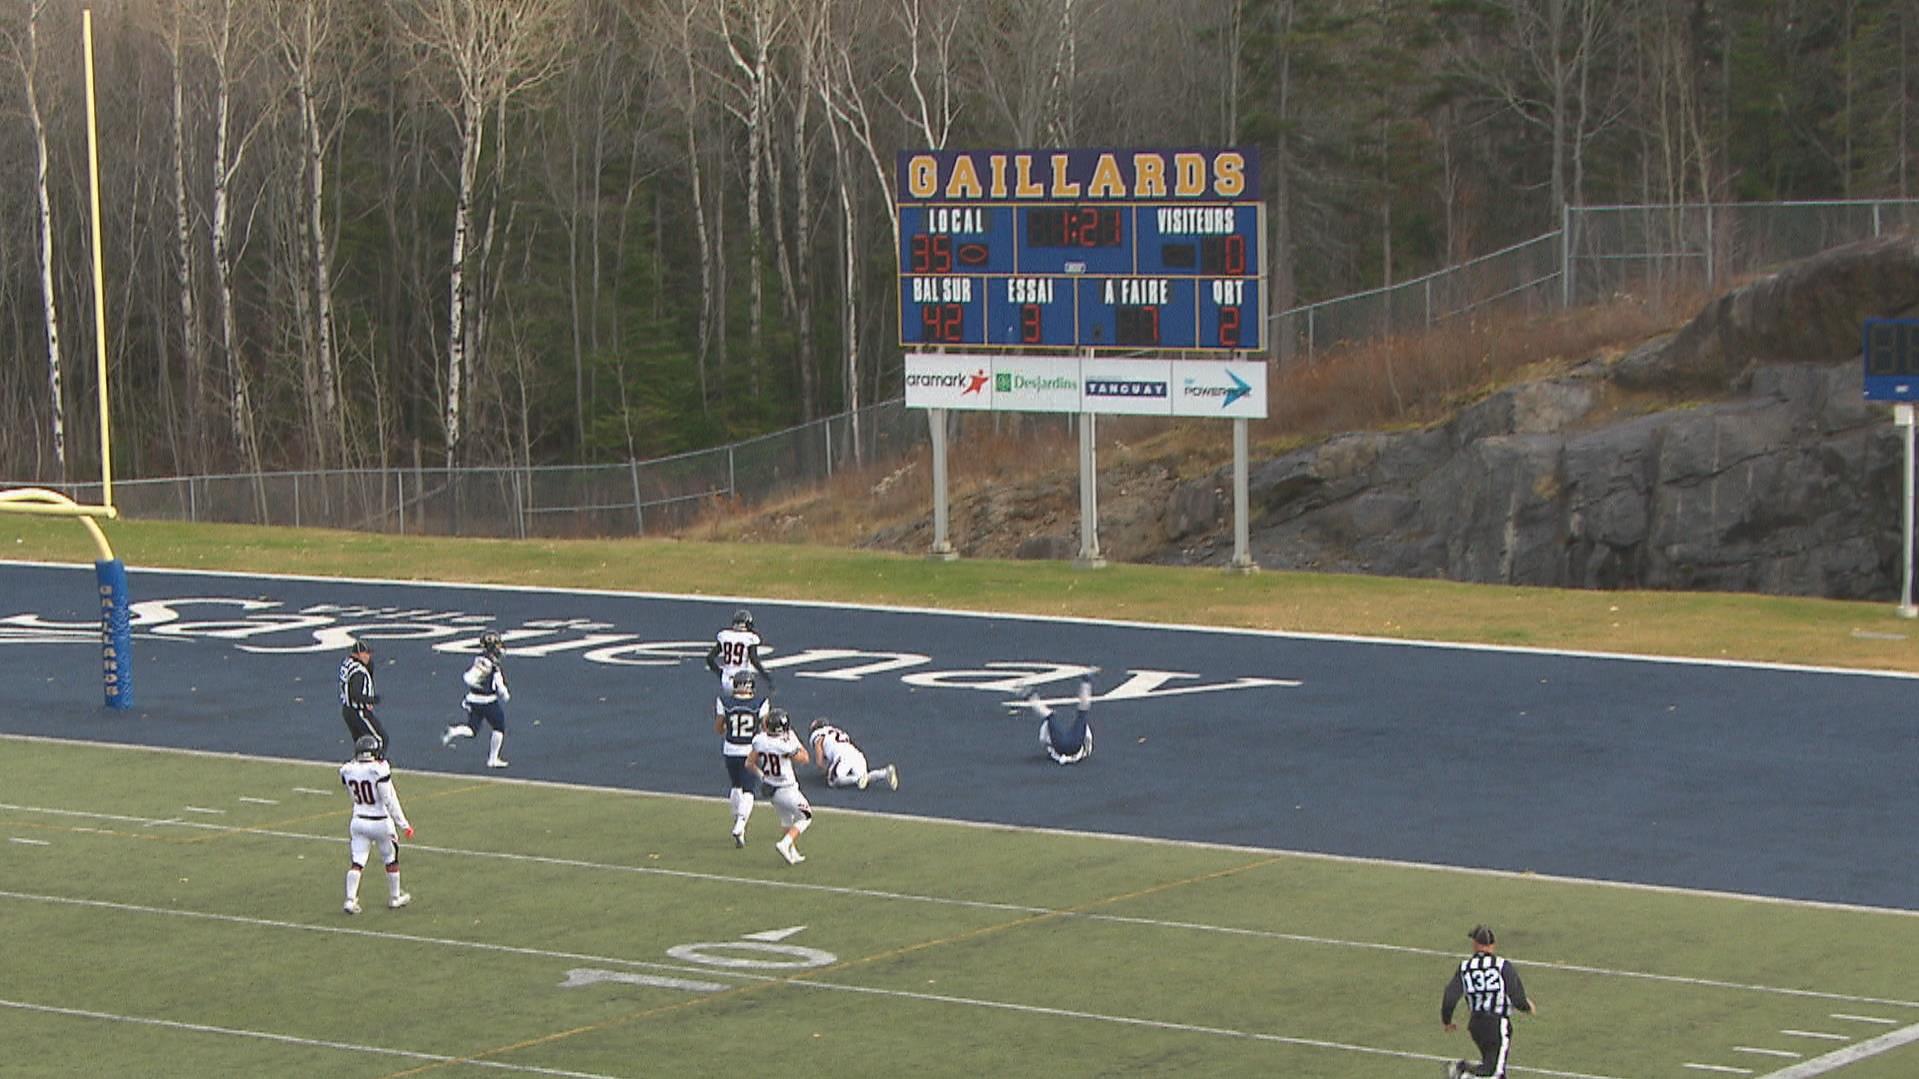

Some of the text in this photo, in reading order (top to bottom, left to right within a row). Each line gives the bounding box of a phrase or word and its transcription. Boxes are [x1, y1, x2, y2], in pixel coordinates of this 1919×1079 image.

[908, 152, 1246, 198] GAILLARDS
[928, 208, 983, 233] LOCAL
[1062, 209, 1121, 247] 1:21
[1157, 208, 1235, 234] VISITEURS
[912, 235, 951, 273] 35
[1225, 235, 1245, 274] 0
[913, 277, 972, 303] BAL SUR
[1007, 279, 1053, 303] ESSAI
[1104, 280, 1168, 305] A FAIRE
[923, 304, 963, 342] 42
[1022, 304, 1041, 343] 3
[1142, 306, 1159, 342] 7
[1219, 307, 1240, 346] 2
[906, 373, 966, 388] aramark
[1014, 375, 1078, 393] Desjardins
[723, 642, 745, 666] 89
[728, 714, 754, 738] 12
[758, 752, 781, 777] 28
[348, 779, 376, 805] 30
[1463, 968, 1501, 993] 132
